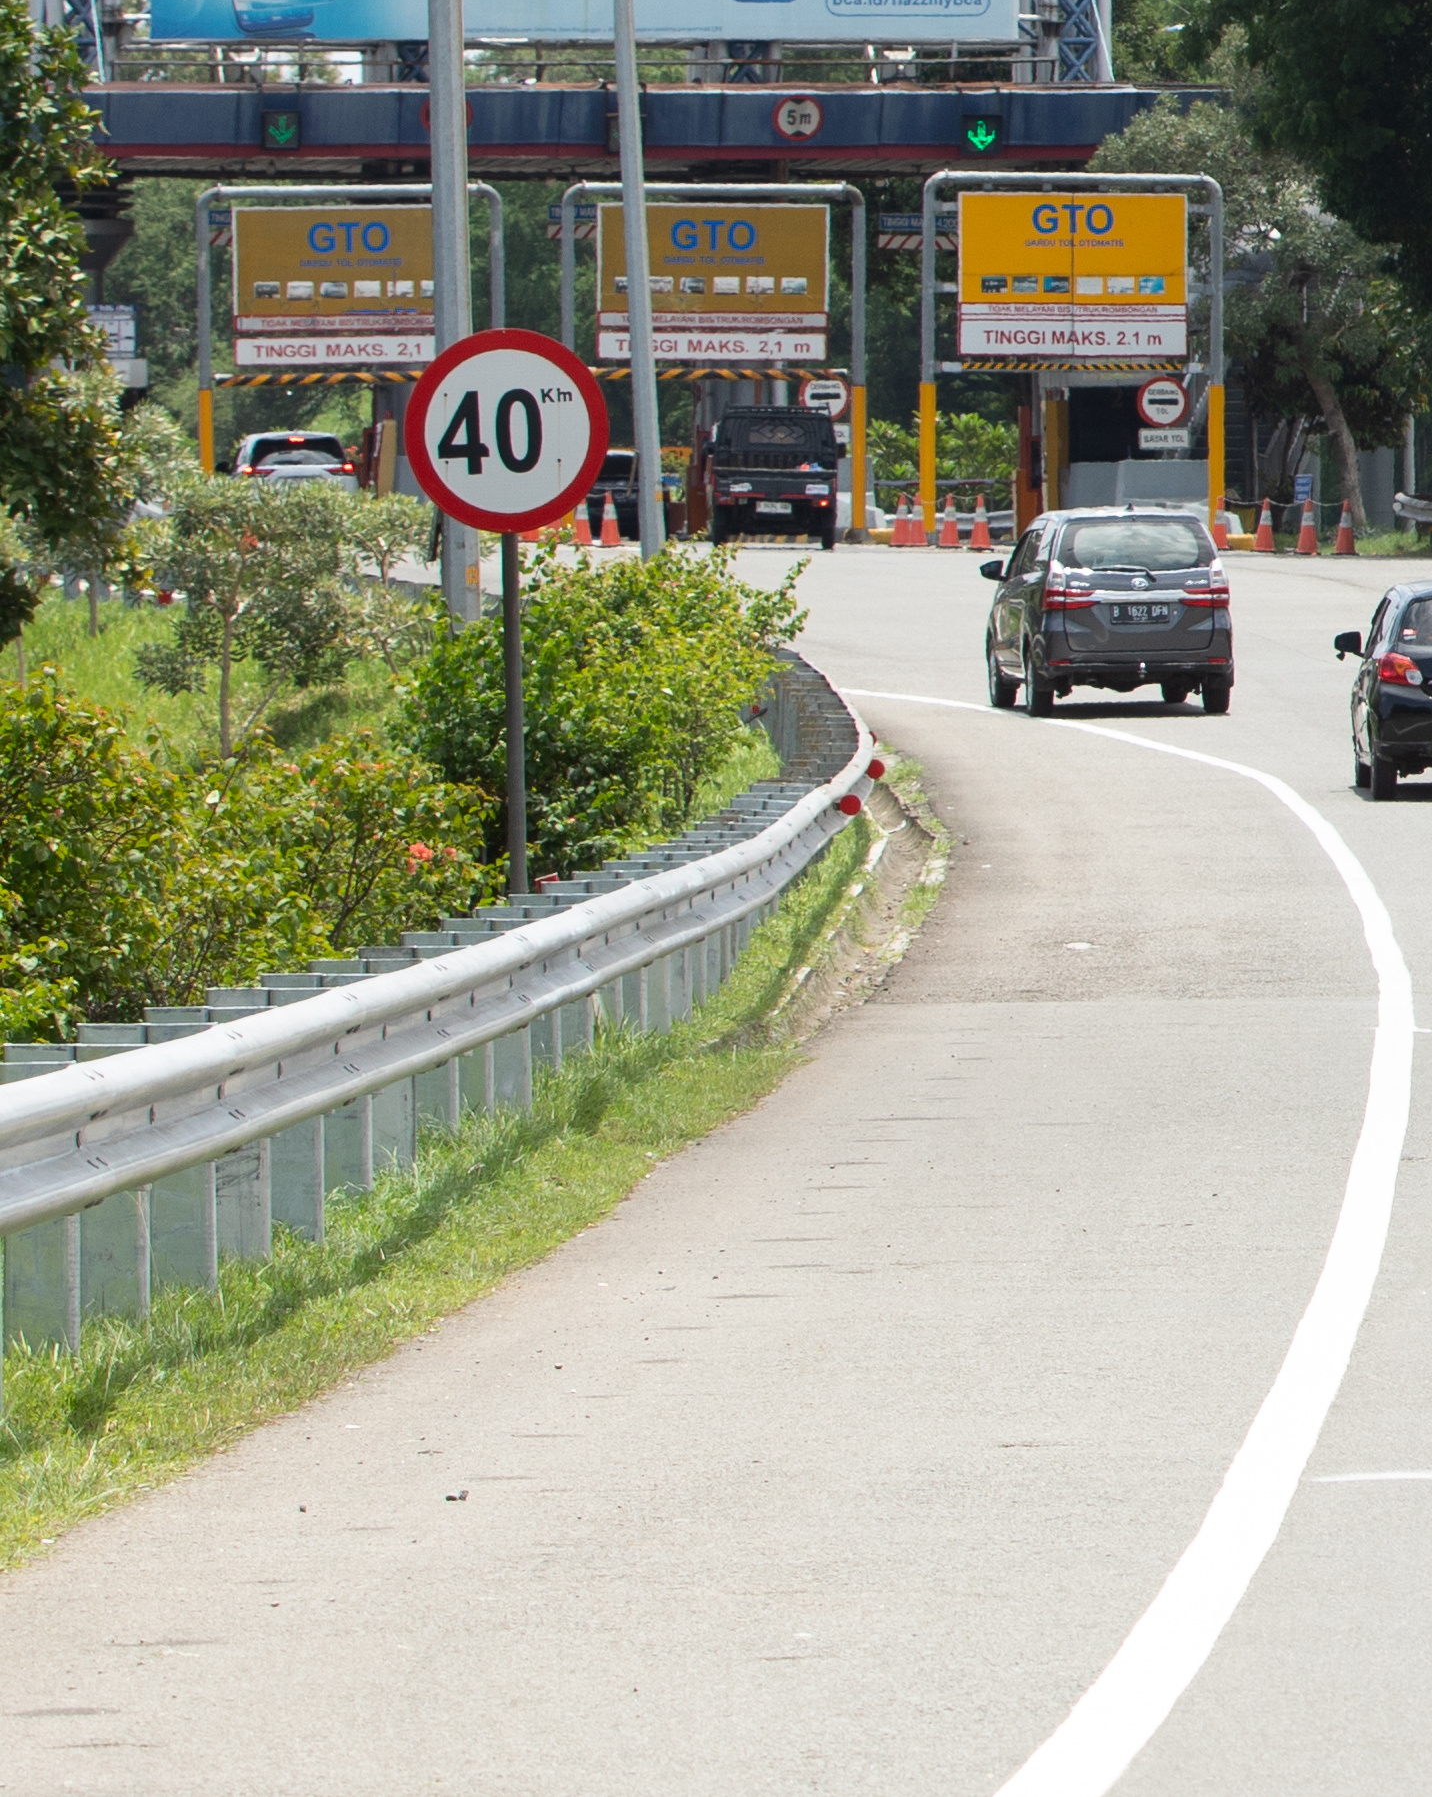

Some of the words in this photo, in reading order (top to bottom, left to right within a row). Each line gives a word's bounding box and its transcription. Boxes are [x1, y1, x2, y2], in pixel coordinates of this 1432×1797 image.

[671, 219, 757, 252] GTO
[1031, 203, 1115, 236] GTO
[307, 220, 392, 254] GTO
[252, 343, 317, 358] TINGGI
[325, 343, 388, 357] MAKS.
[397, 342, 422, 359] 2,1
[687, 339, 749, 353] MAKS.
[758, 340, 783, 355] 2,1
[793, 342, 811, 353] m
[982, 329, 1046, 346] TINGGI
[1051, 330, 1111, 347] MAKS.
[1116, 331, 1140, 346] 2.1
[1147, 333, 1162, 346] m
[437, 387, 543, 475] 40
[540, 387, 573, 403] Km
